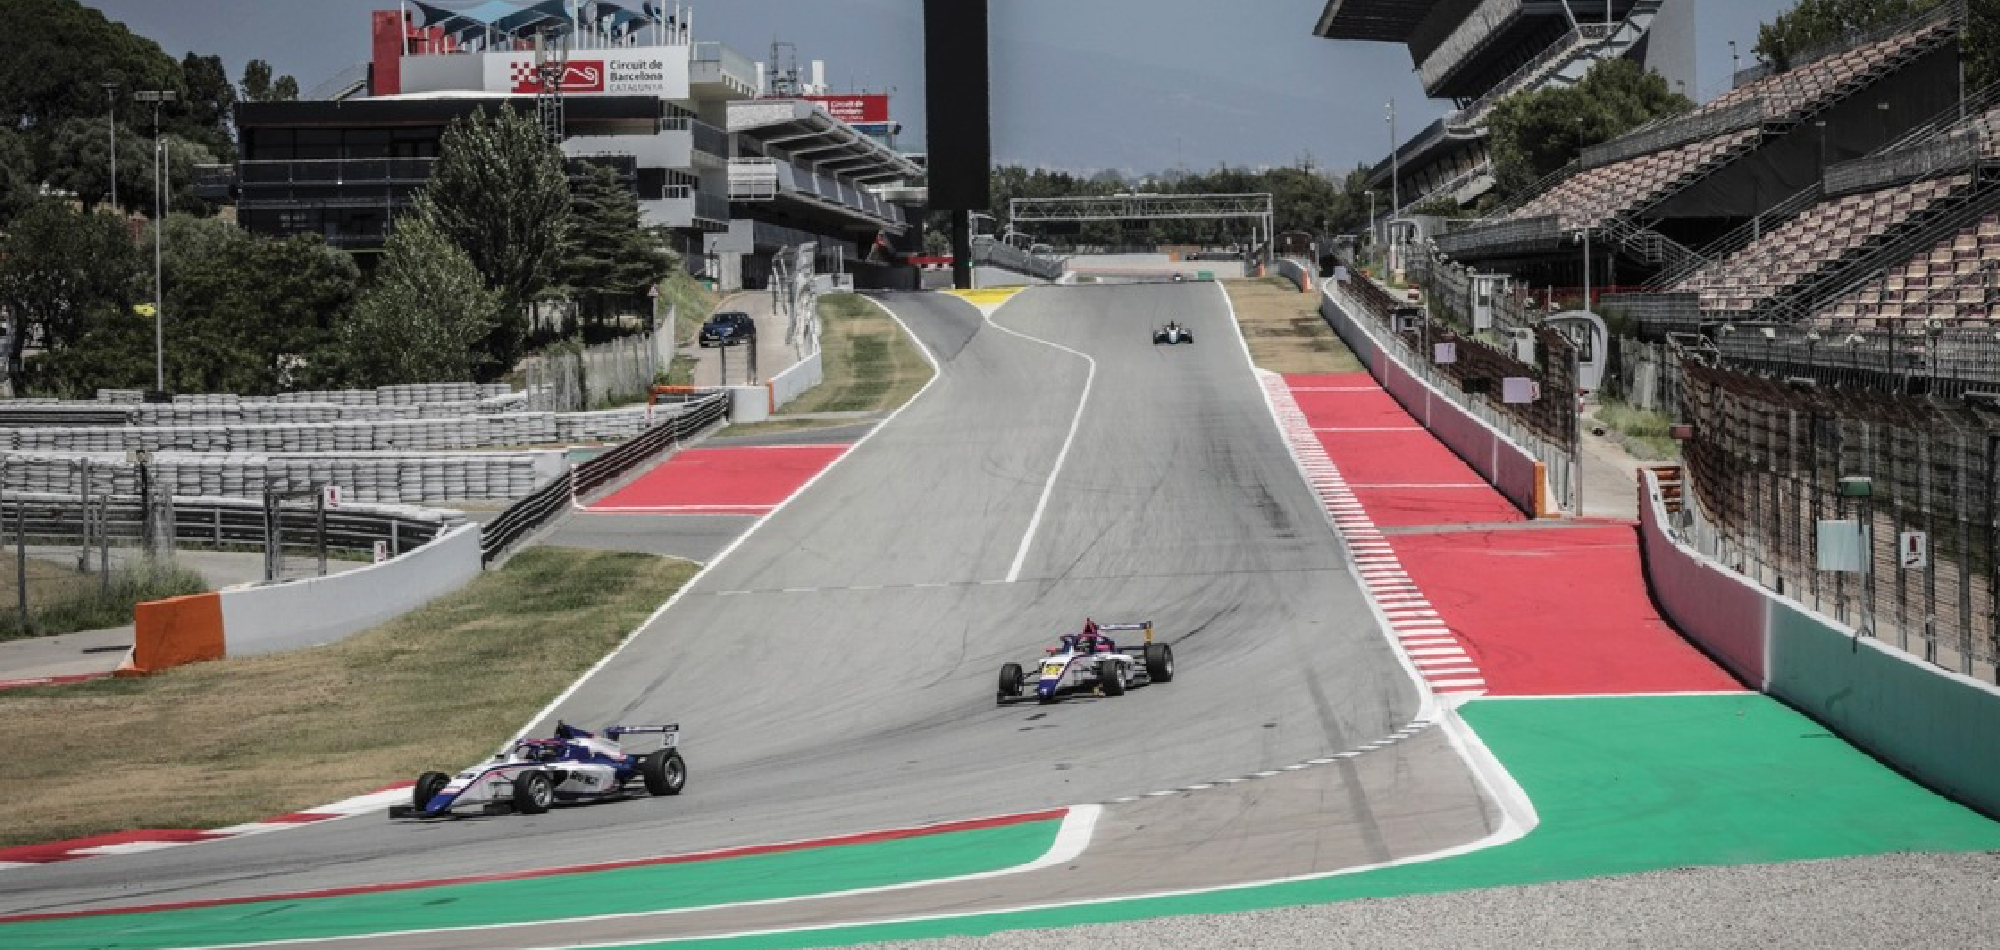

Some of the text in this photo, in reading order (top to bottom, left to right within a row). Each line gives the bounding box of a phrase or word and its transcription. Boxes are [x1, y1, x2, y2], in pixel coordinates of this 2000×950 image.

[610, 60, 662, 69] Circuit de
[610, 71, 663, 81] Barcelona
